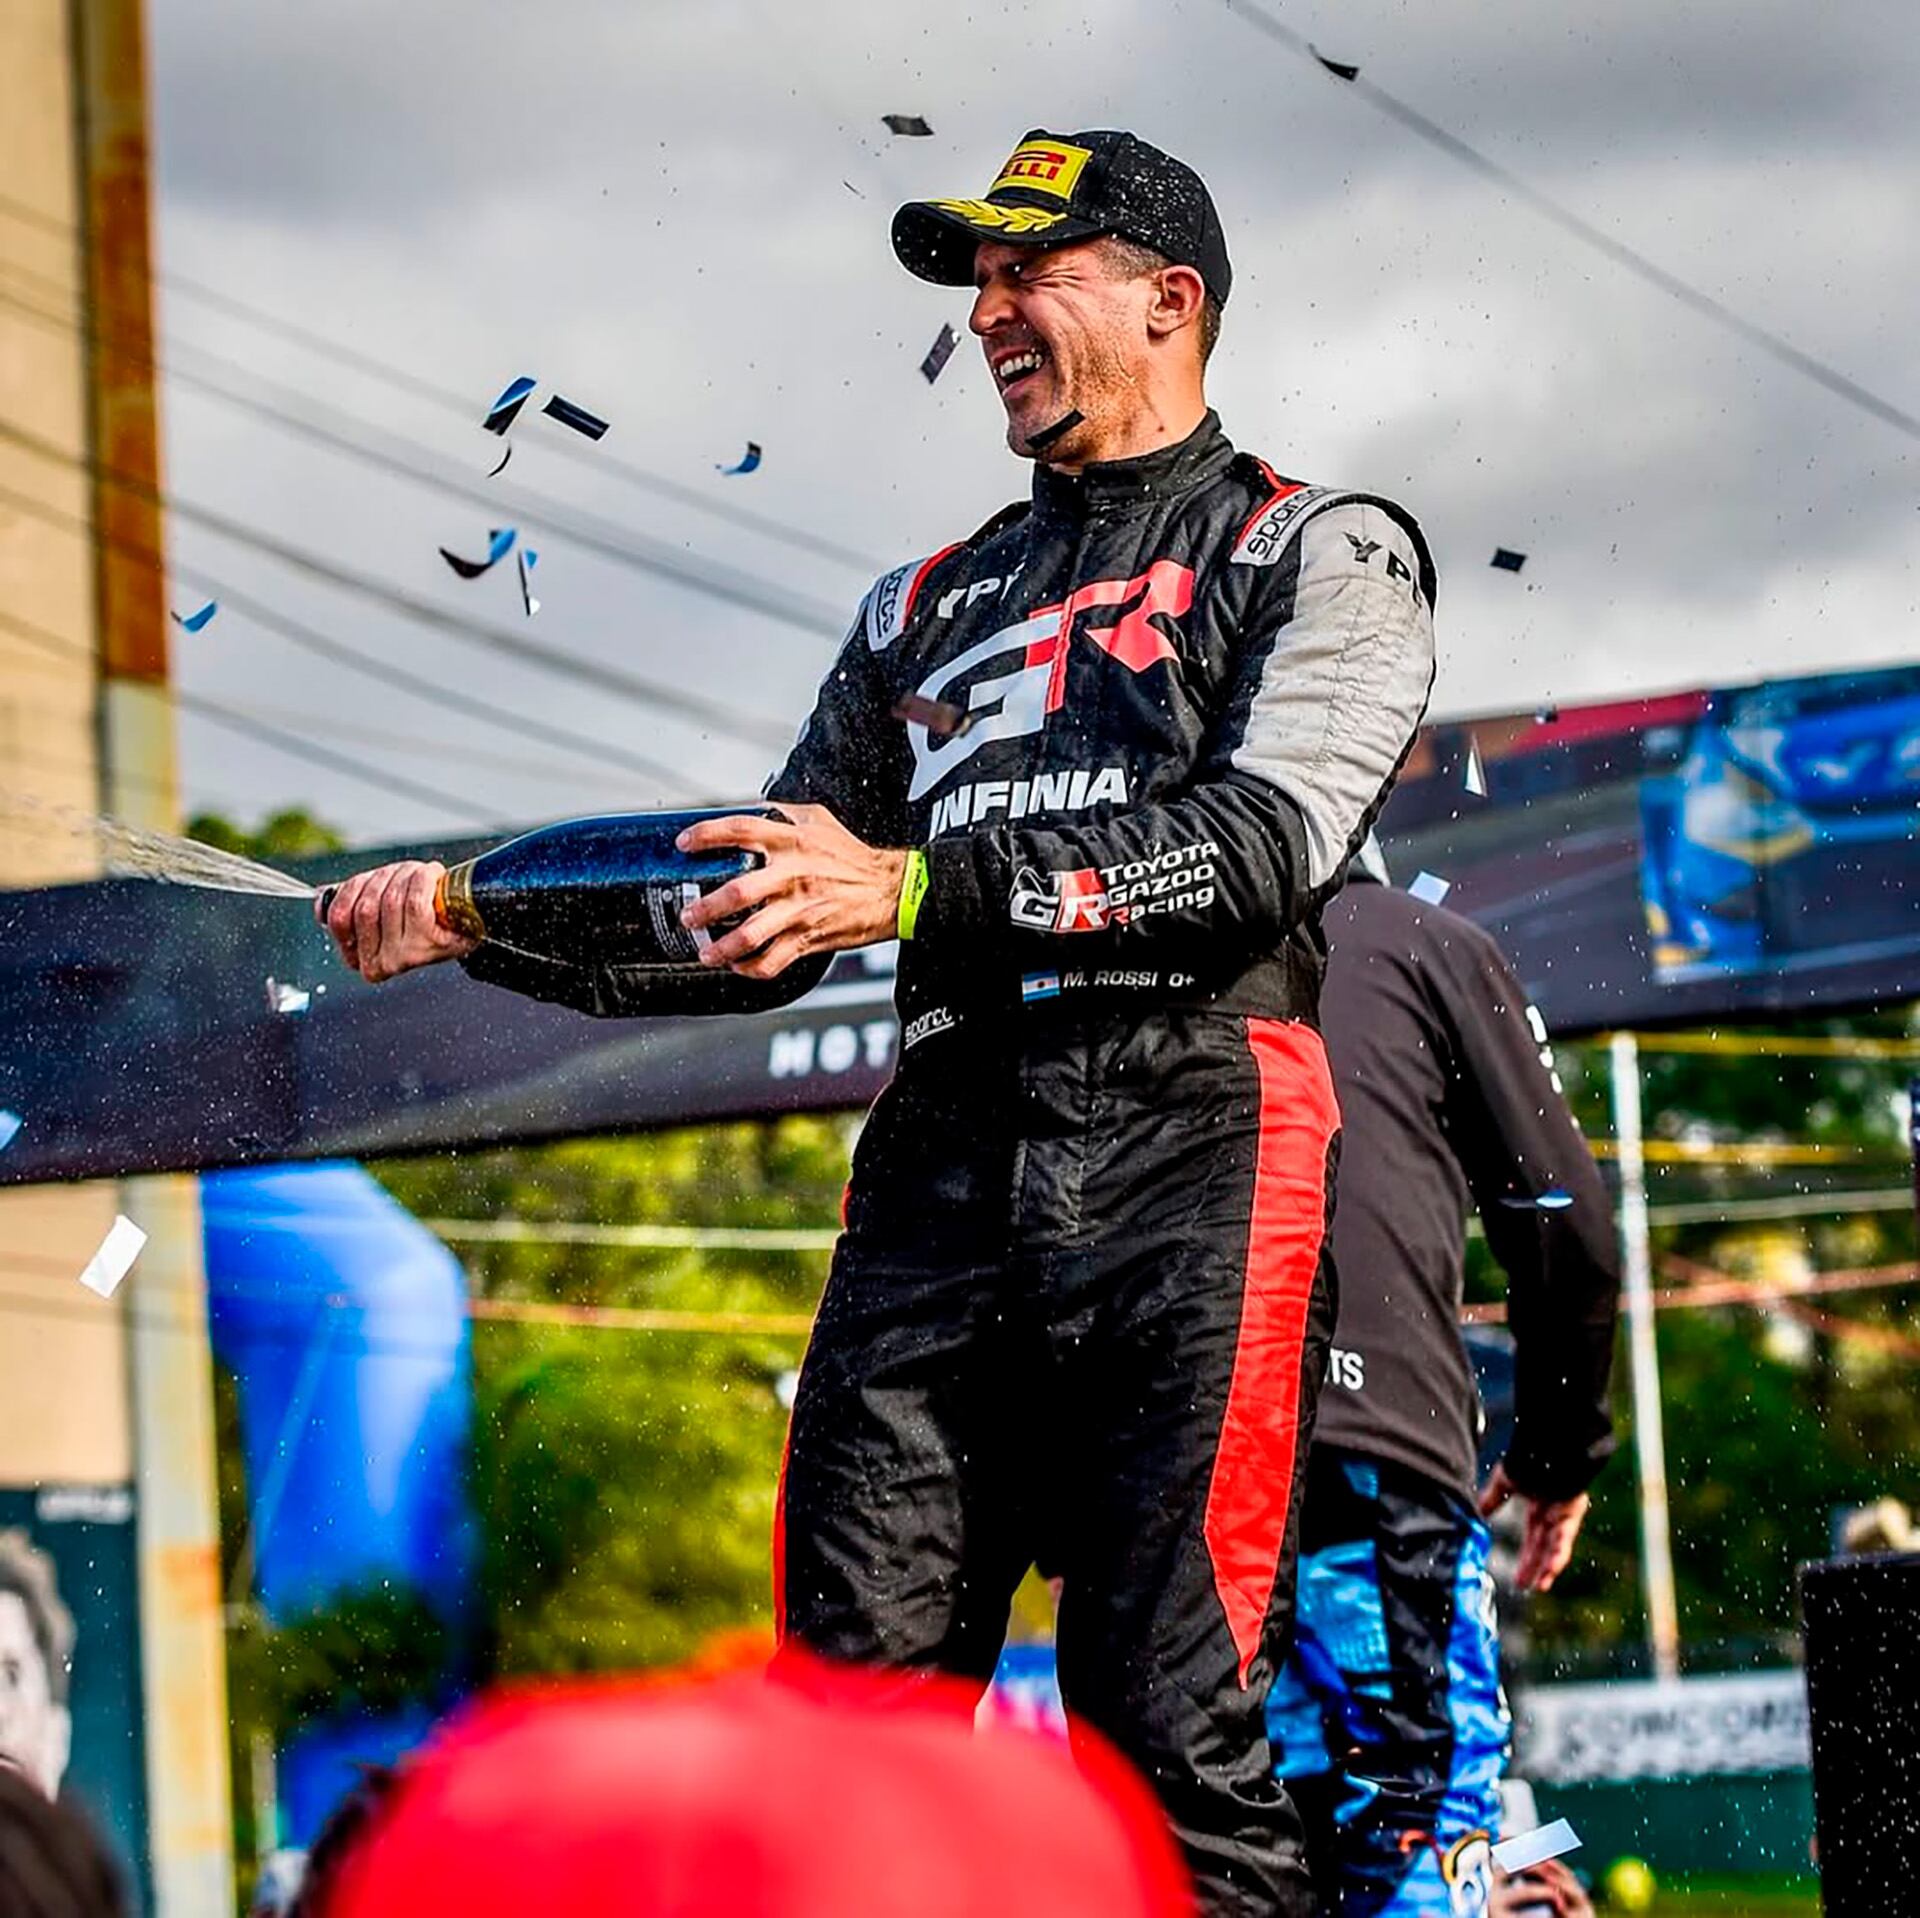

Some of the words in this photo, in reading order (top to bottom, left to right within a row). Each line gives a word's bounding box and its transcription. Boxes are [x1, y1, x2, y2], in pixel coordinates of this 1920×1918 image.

[1000, 156, 1061, 181] ELLI
[1343, 532, 1420, 602] YP
[928, 767, 1128, 842] INFINIA
[1099, 841, 1220, 886] TOYOTA
[1107, 863, 1215, 907] GAZOO
[1010, 884, 1110, 930] GR
[1112, 886, 1214, 925] Racing
[1063, 970, 1088, 988] M.
[1094, 970, 1158, 988] ROSSI
